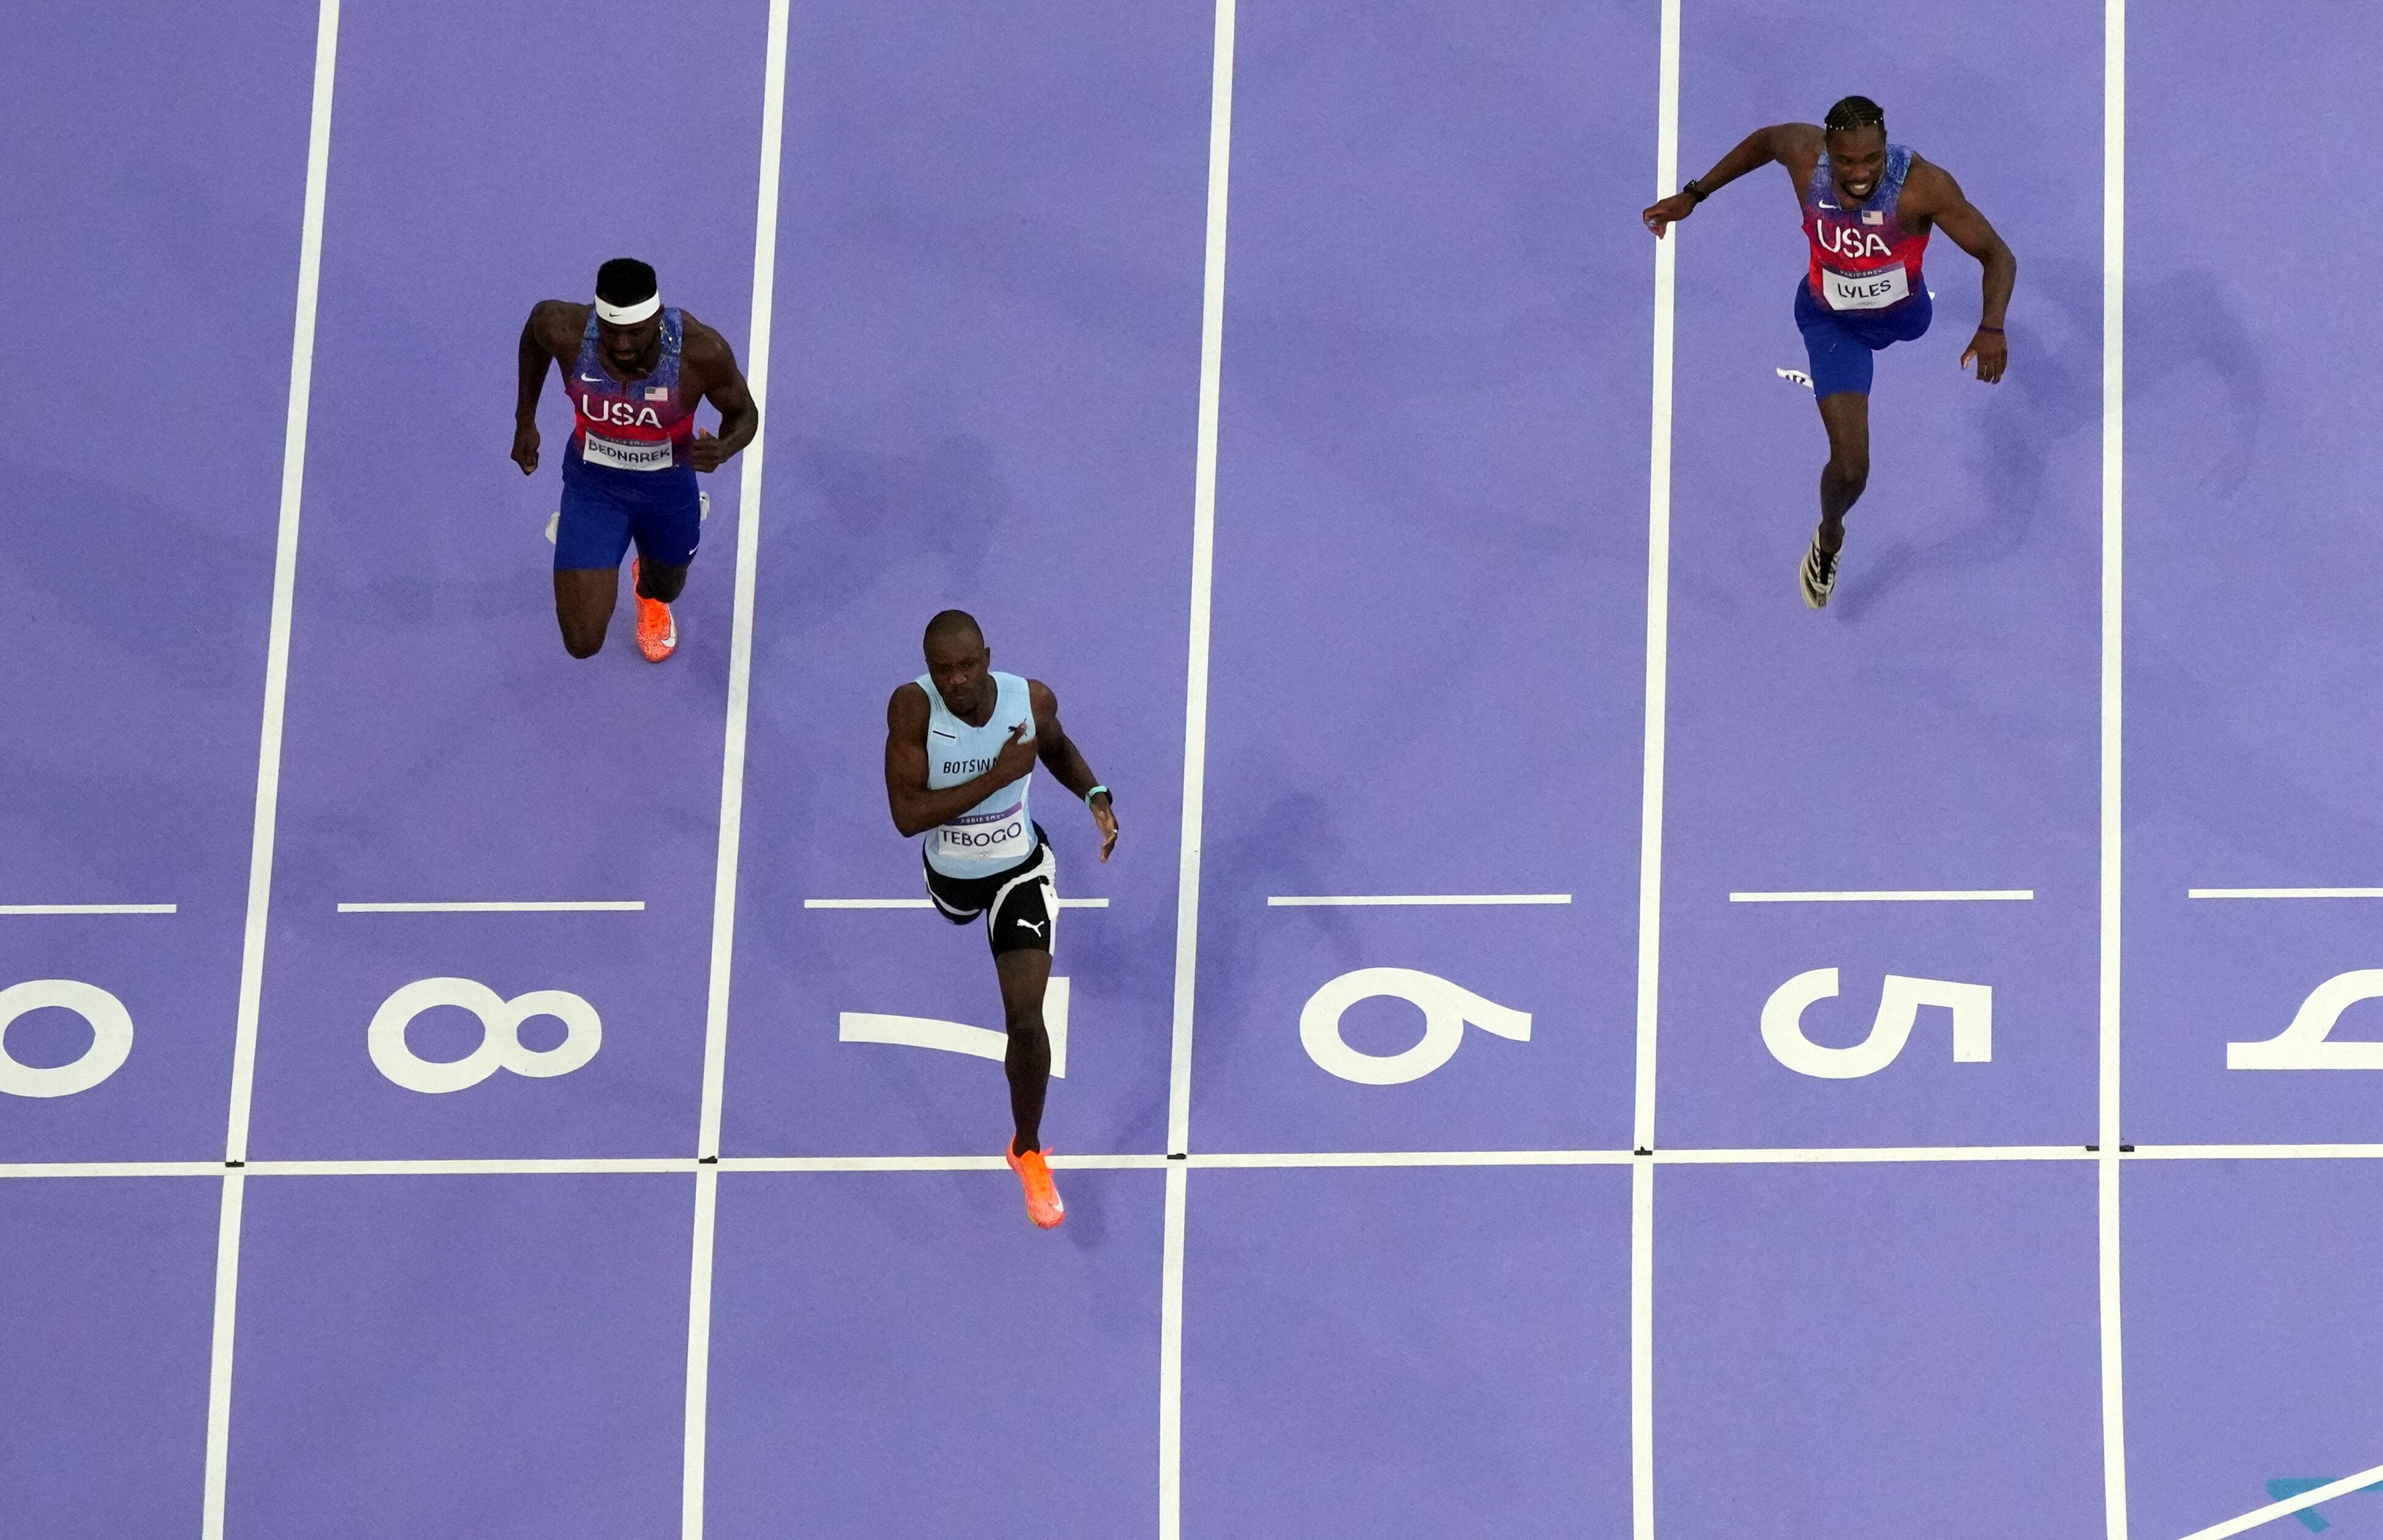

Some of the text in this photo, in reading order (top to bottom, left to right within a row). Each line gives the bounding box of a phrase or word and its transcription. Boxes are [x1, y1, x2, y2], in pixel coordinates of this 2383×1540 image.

[1817, 219, 1892, 258] USA
[1837, 280, 1892, 298] LYLES
[583, 394, 662, 429] USA
[589, 439, 670, 463] BEDNAREK
[943, 757, 999, 774] BOTSWA
[940, 822, 1021, 847] TEBOGO
[368, 977, 602, 1093] 8
[839, 977, 1070, 1079] 7
[1300, 967, 1532, 1085] 6
[1761, 967, 1992, 1079] 5
